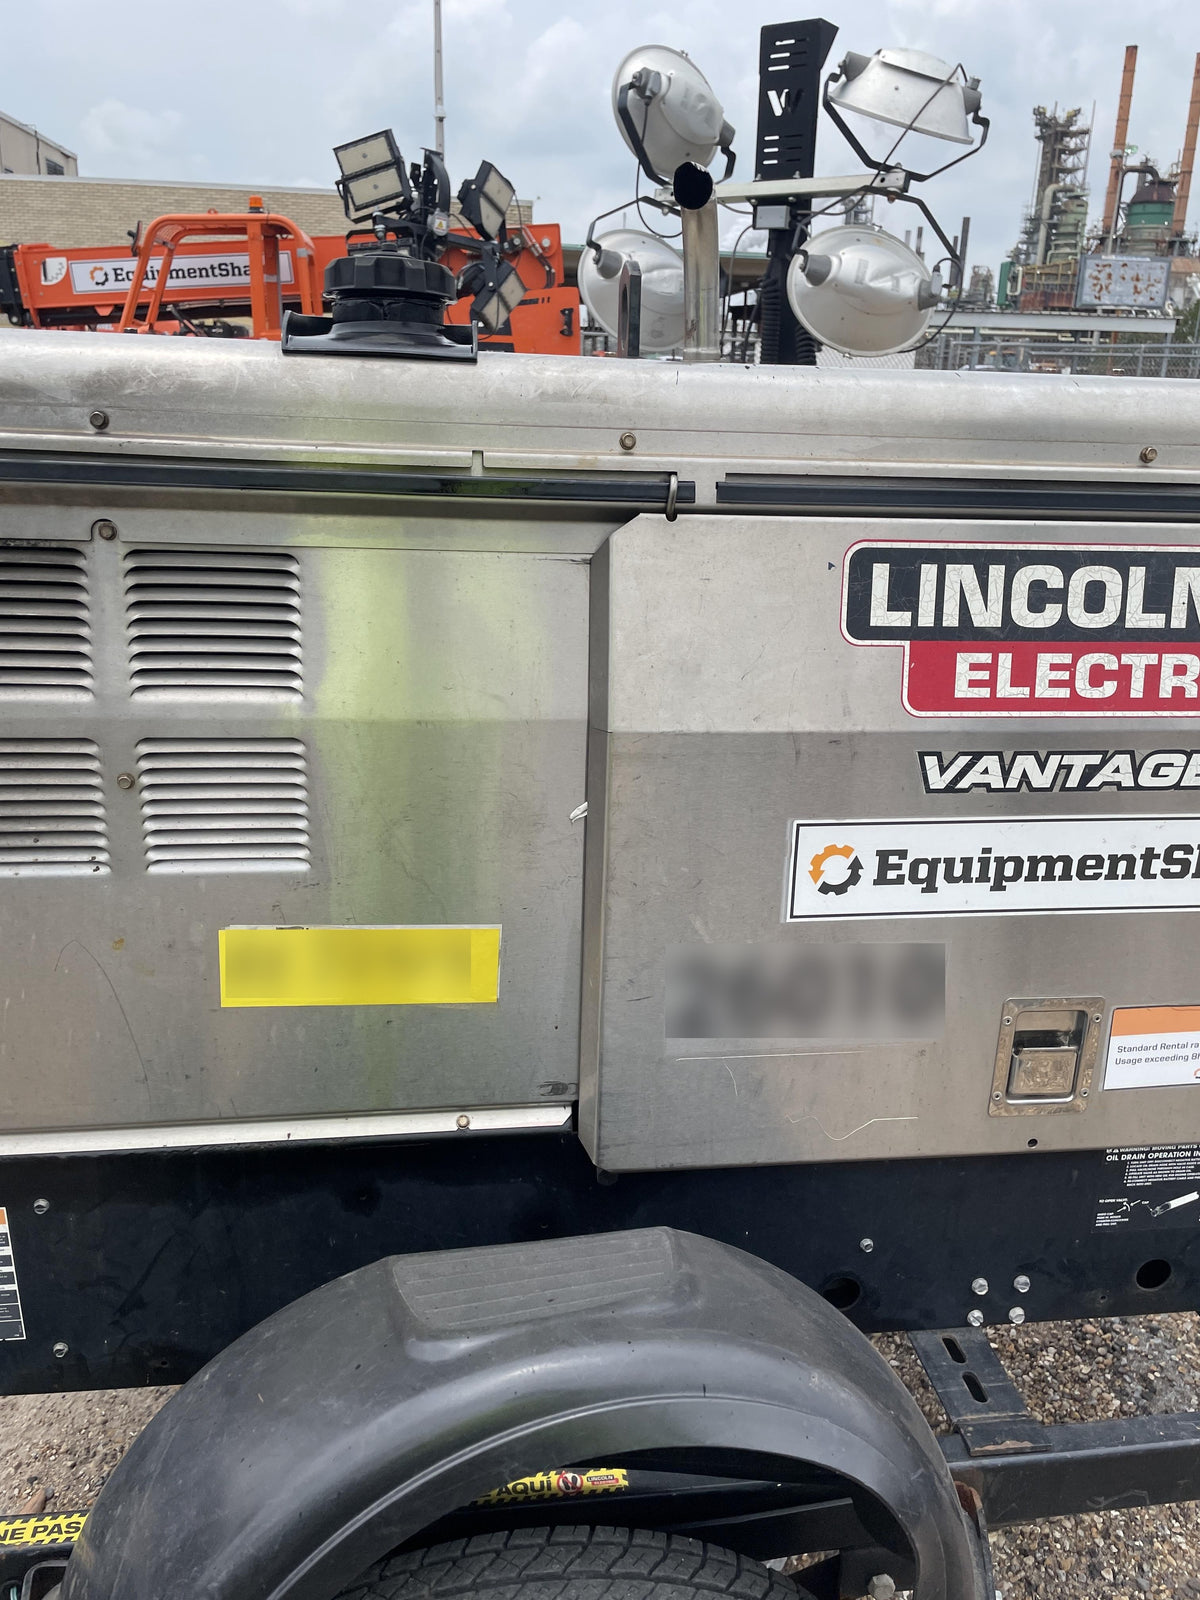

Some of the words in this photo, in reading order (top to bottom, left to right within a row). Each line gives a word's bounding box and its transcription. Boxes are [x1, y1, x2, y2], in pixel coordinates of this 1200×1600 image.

[112, 262, 250, 282] EimentSha
[954, 652, 1200, 698] ELECTR
[873, 844, 1200, 893] EquipmentS
[1117, 1044, 1158, 1053] Standard
[1160, 1042, 1189, 1050] Rental
[1115, 1057, 1143, 1066] Usage
[1144, 1053, 1189, 1062] exceeding
[1147, 1151, 1191, 1159] OPERATION
[31, 1521, 82, 1538] PAS
